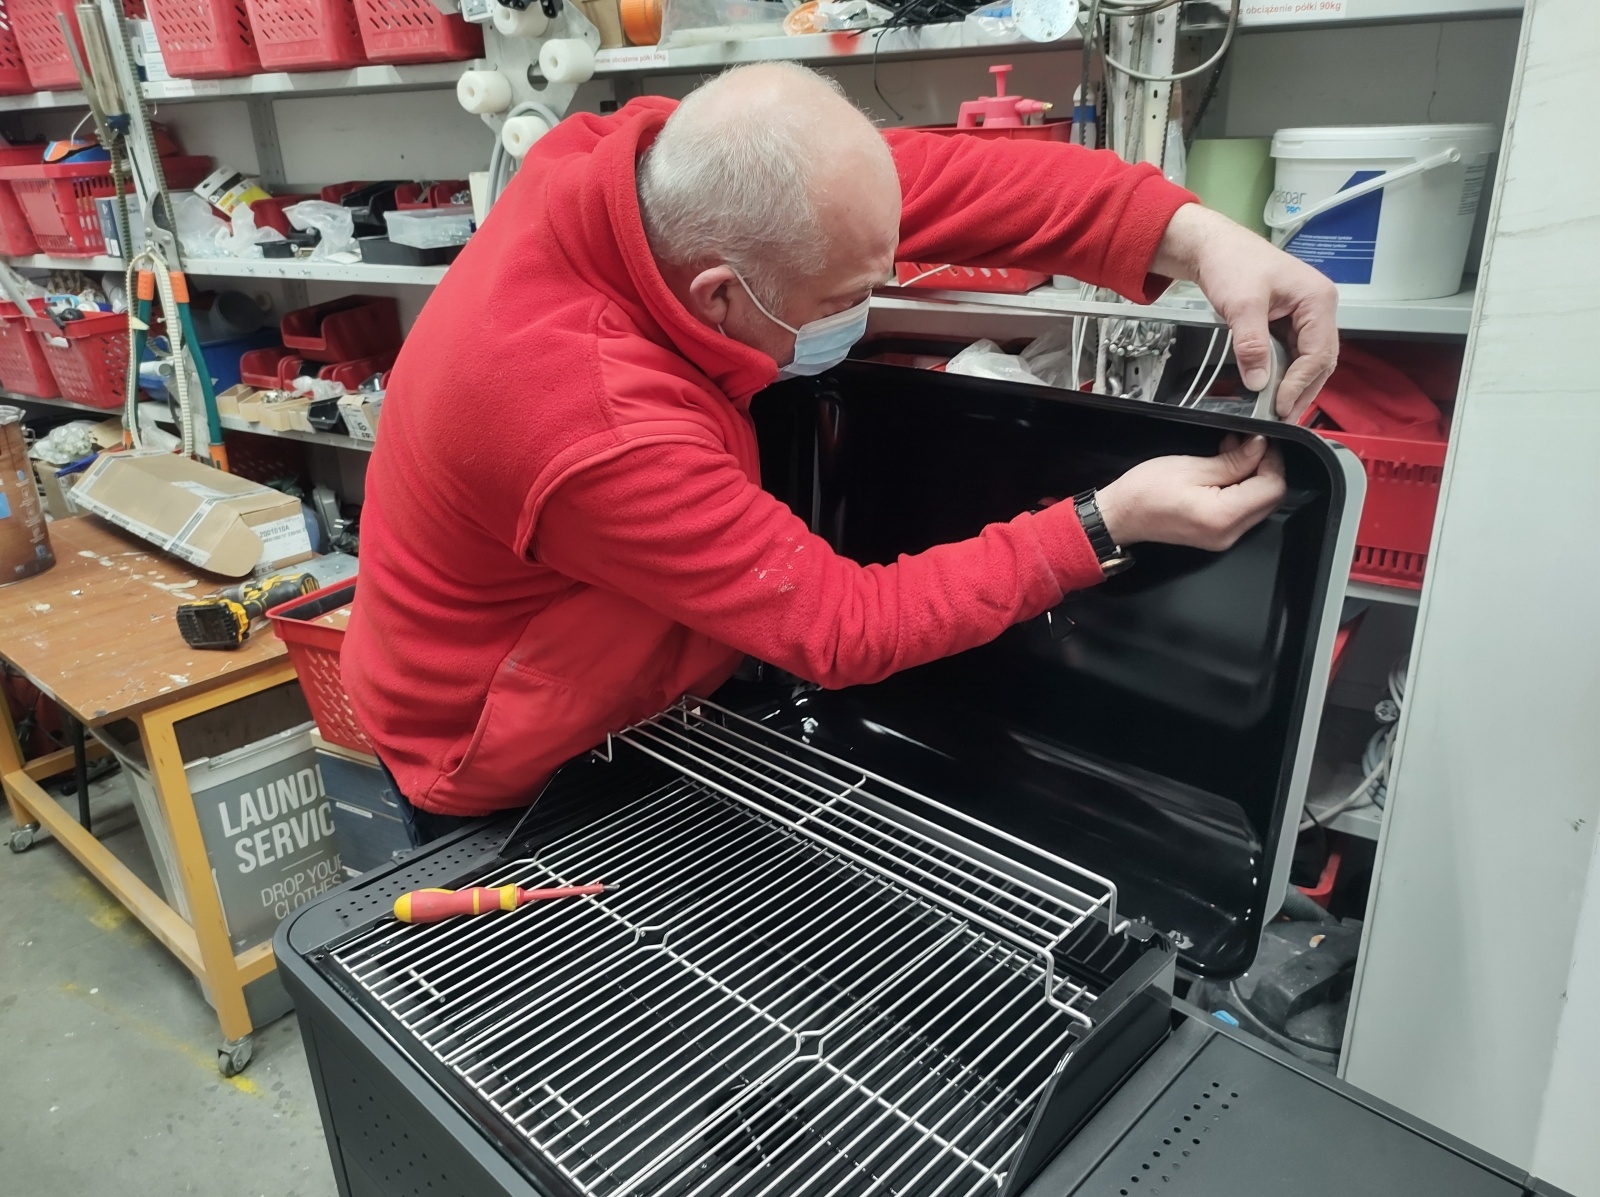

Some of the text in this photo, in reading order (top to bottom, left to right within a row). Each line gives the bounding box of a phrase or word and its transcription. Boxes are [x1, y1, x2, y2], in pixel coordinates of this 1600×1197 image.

[1246, 4, 1293, 15] obciążenie
[1295, 2, 1318, 13] półki
[1320, 2, 1342, 12] 90kg
[1275, 186, 1307, 206] alspar
[234, 801, 336, 874] SERVIC
[260, 872, 305, 907] DROP
